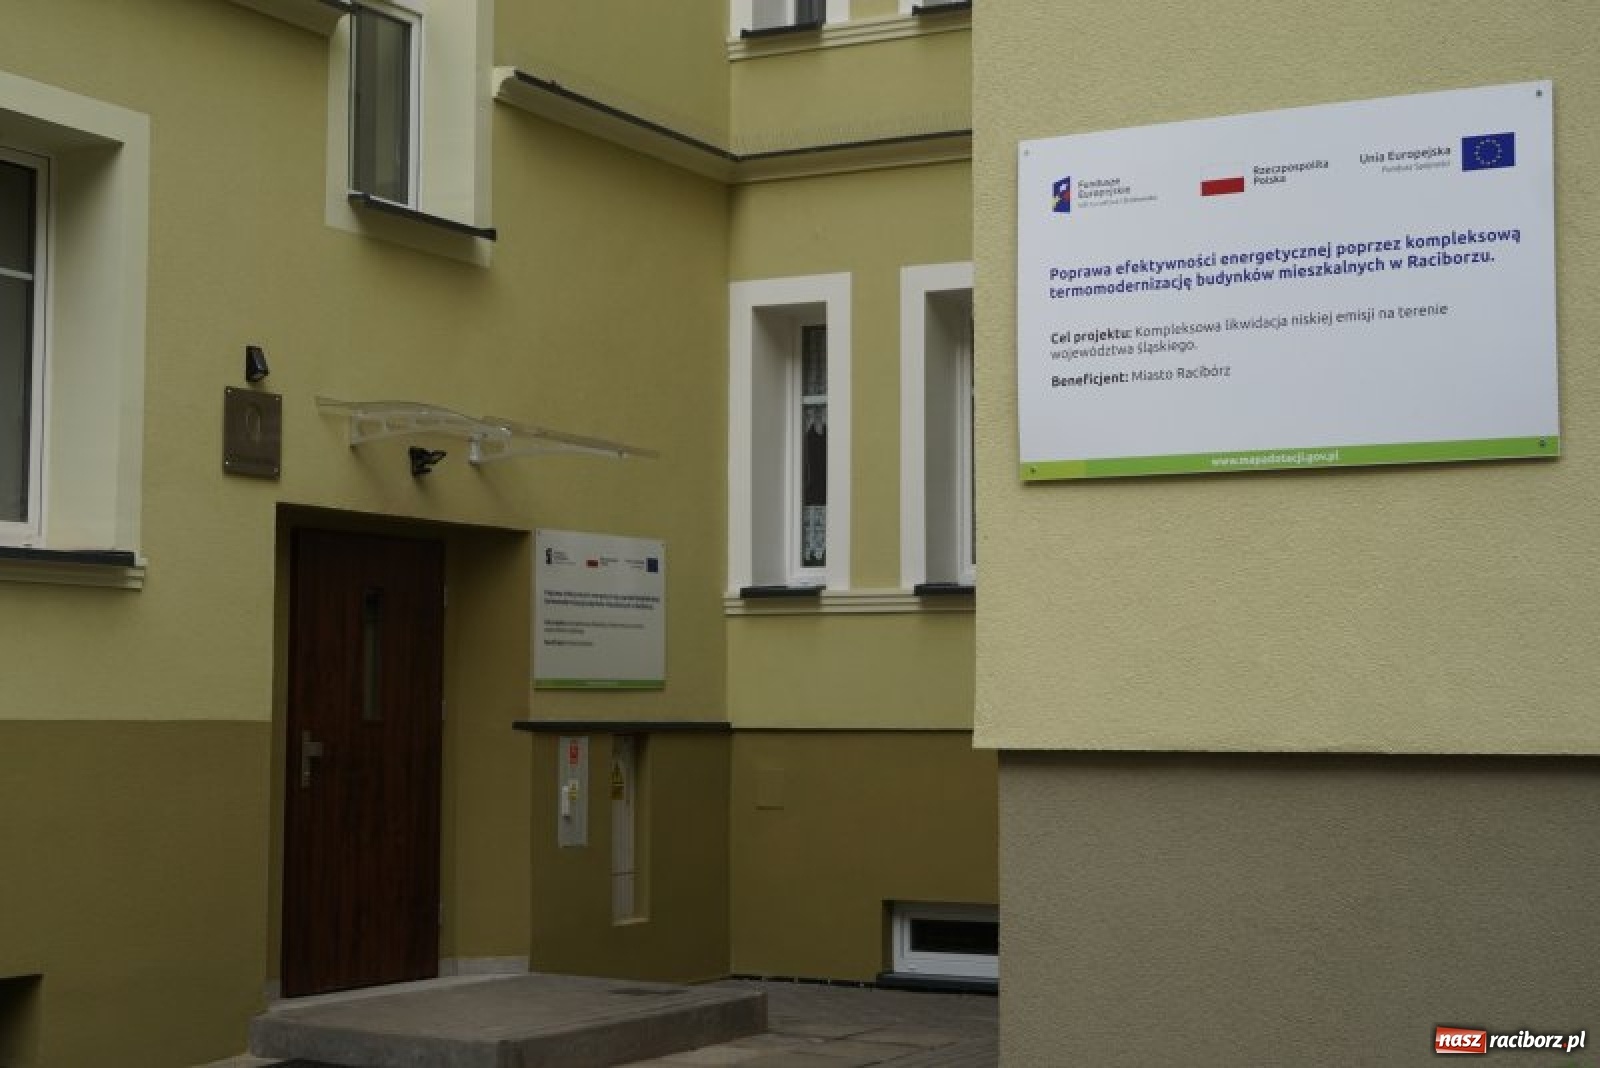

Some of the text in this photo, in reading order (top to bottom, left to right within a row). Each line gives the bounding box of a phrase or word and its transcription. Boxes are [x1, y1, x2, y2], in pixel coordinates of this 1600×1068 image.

[1360, 147, 1451, 164] Unia Europejska
[1253, 160, 1329, 174] Rzeczpospolita
[1253, 176, 1287, 186] Polska
[1049, 229, 1521, 282] Poprawa efektywności energetycznej poprzez kompleksową
[1049, 251, 1495, 298] termomodernizację budynków mieszkalnych w Raciborzu.
[1050, 304, 1449, 345] Cel projektu: Kompleksowa likwidacja niskiej emisji na terenie
[1050, 340, 1198, 361] województwa śląskiego.
[1050, 364, 1231, 387] Beneficjent: Miasto Racibórz
